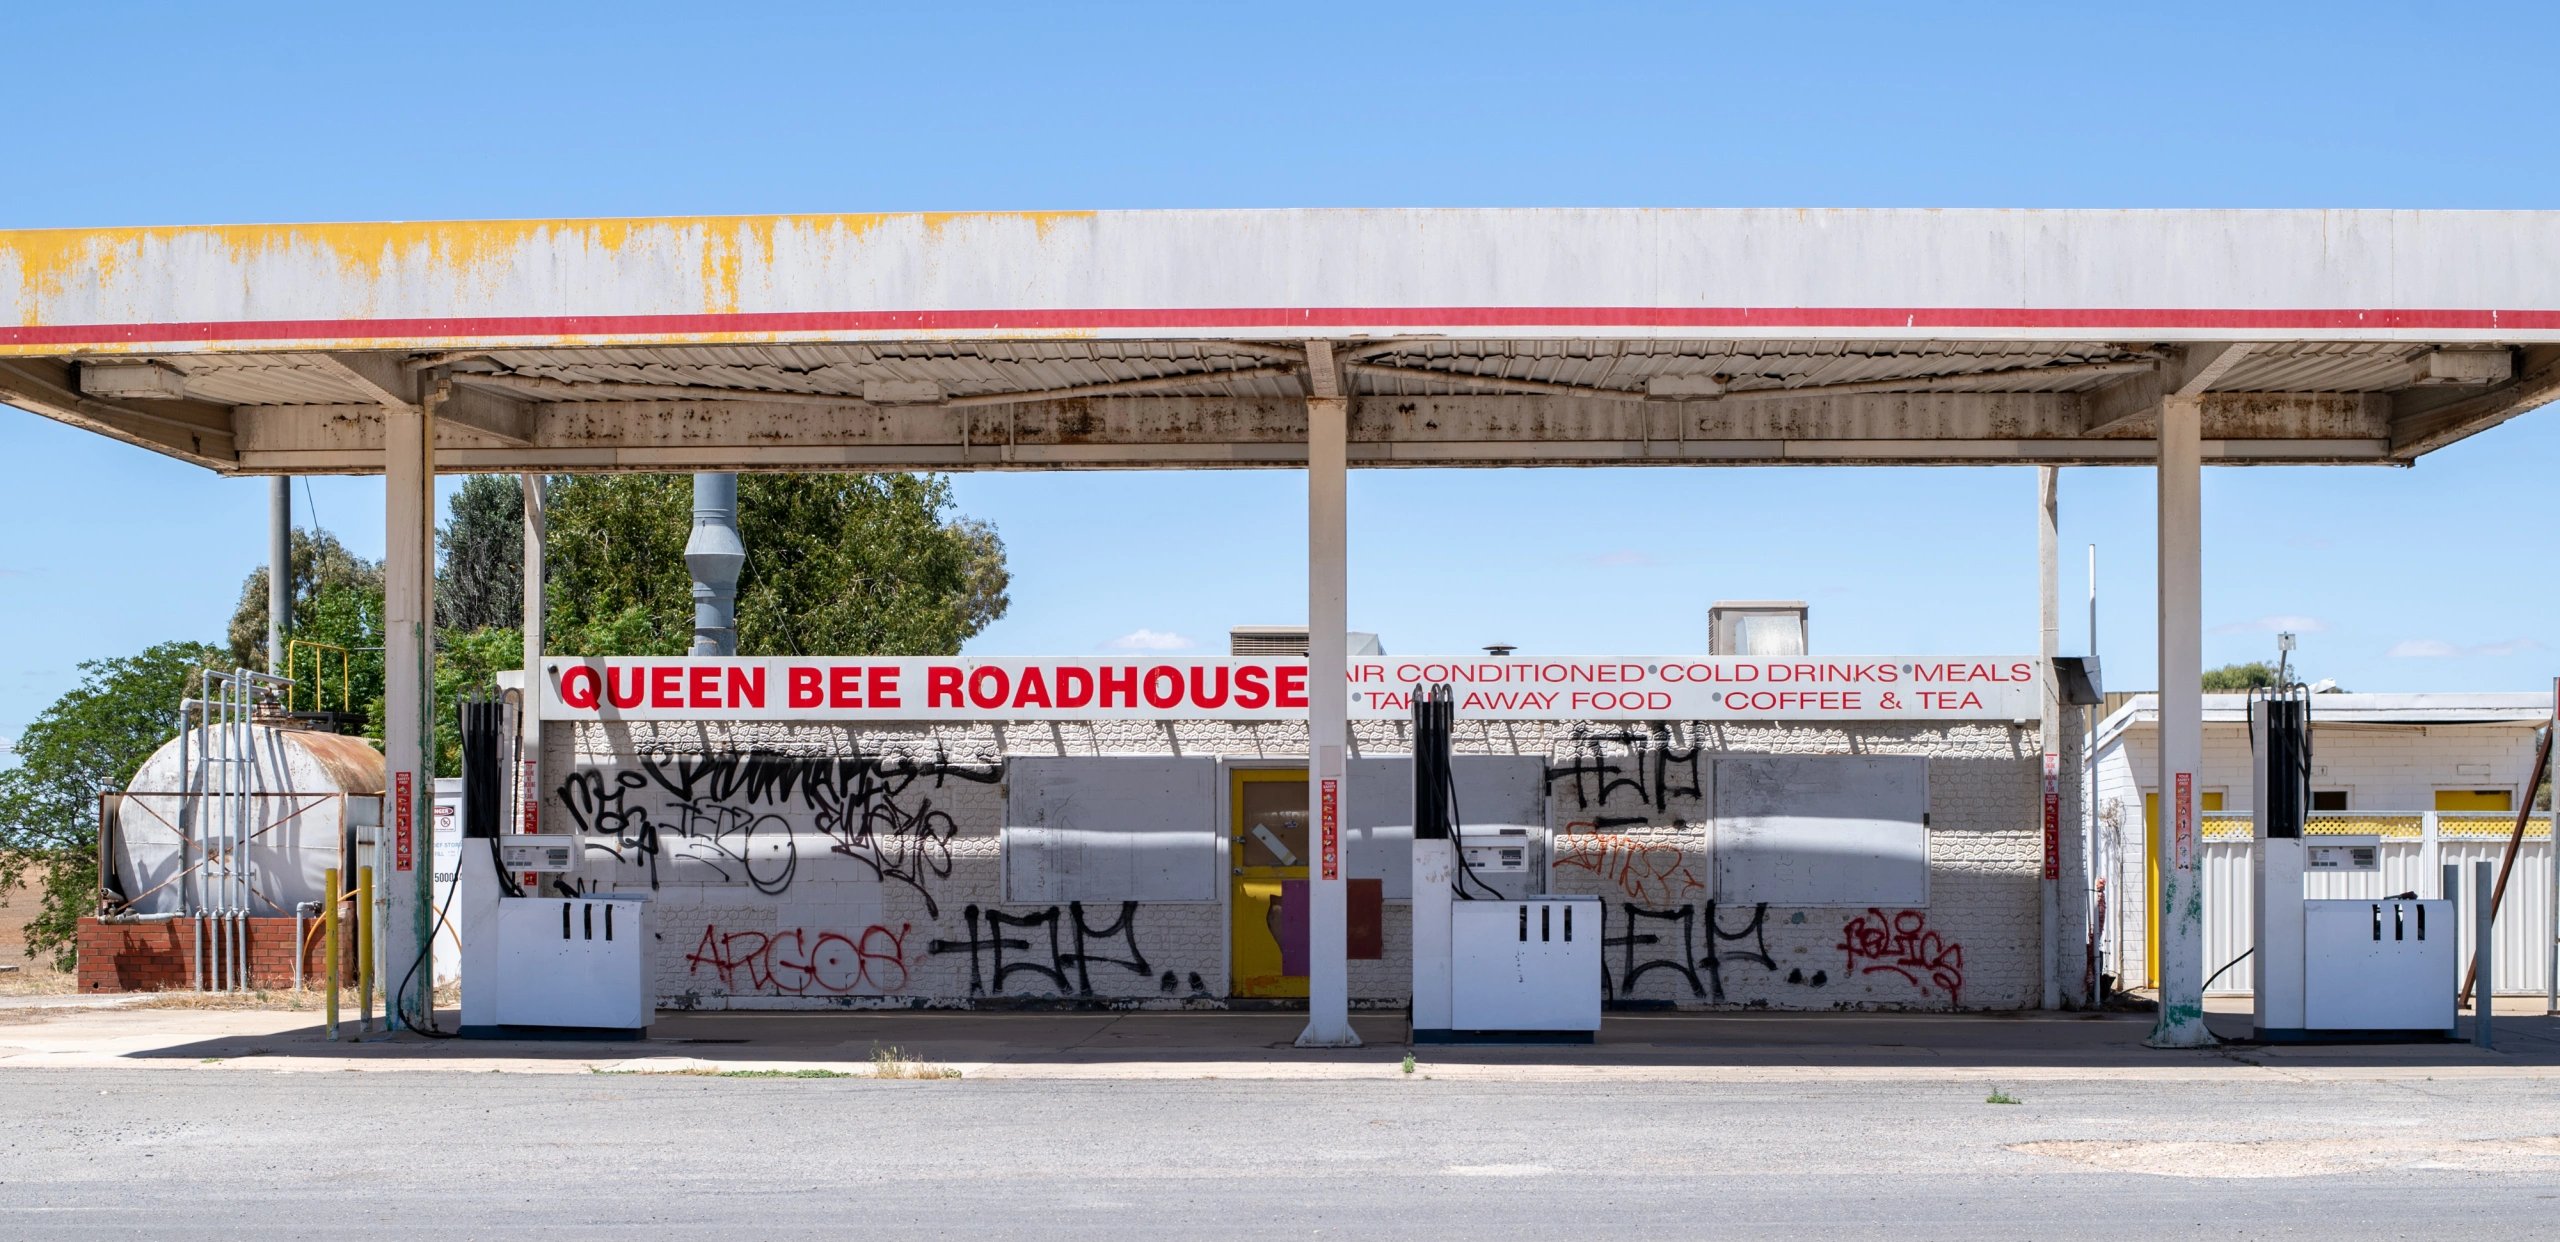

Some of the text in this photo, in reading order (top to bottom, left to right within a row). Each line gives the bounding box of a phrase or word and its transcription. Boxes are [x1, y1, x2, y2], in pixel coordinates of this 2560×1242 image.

[1397, 664, 1645, 683] CONDITIONED
[1660, 664, 1759, 683] COLD
[1767, 664, 1899, 683] DRINKS
[1914, 664, 2032, 683] MEALS
[560, 665, 1310, 712] QUEEN BEE ROADHOUSE
[1461, 692, 1559, 710] AWAY
[1571, 692, 1672, 710] FOOD
[1724, 691, 1861, 710] COFFEE
[1879, 692, 1901, 710] &
[1916, 692, 1983, 710] TEA
